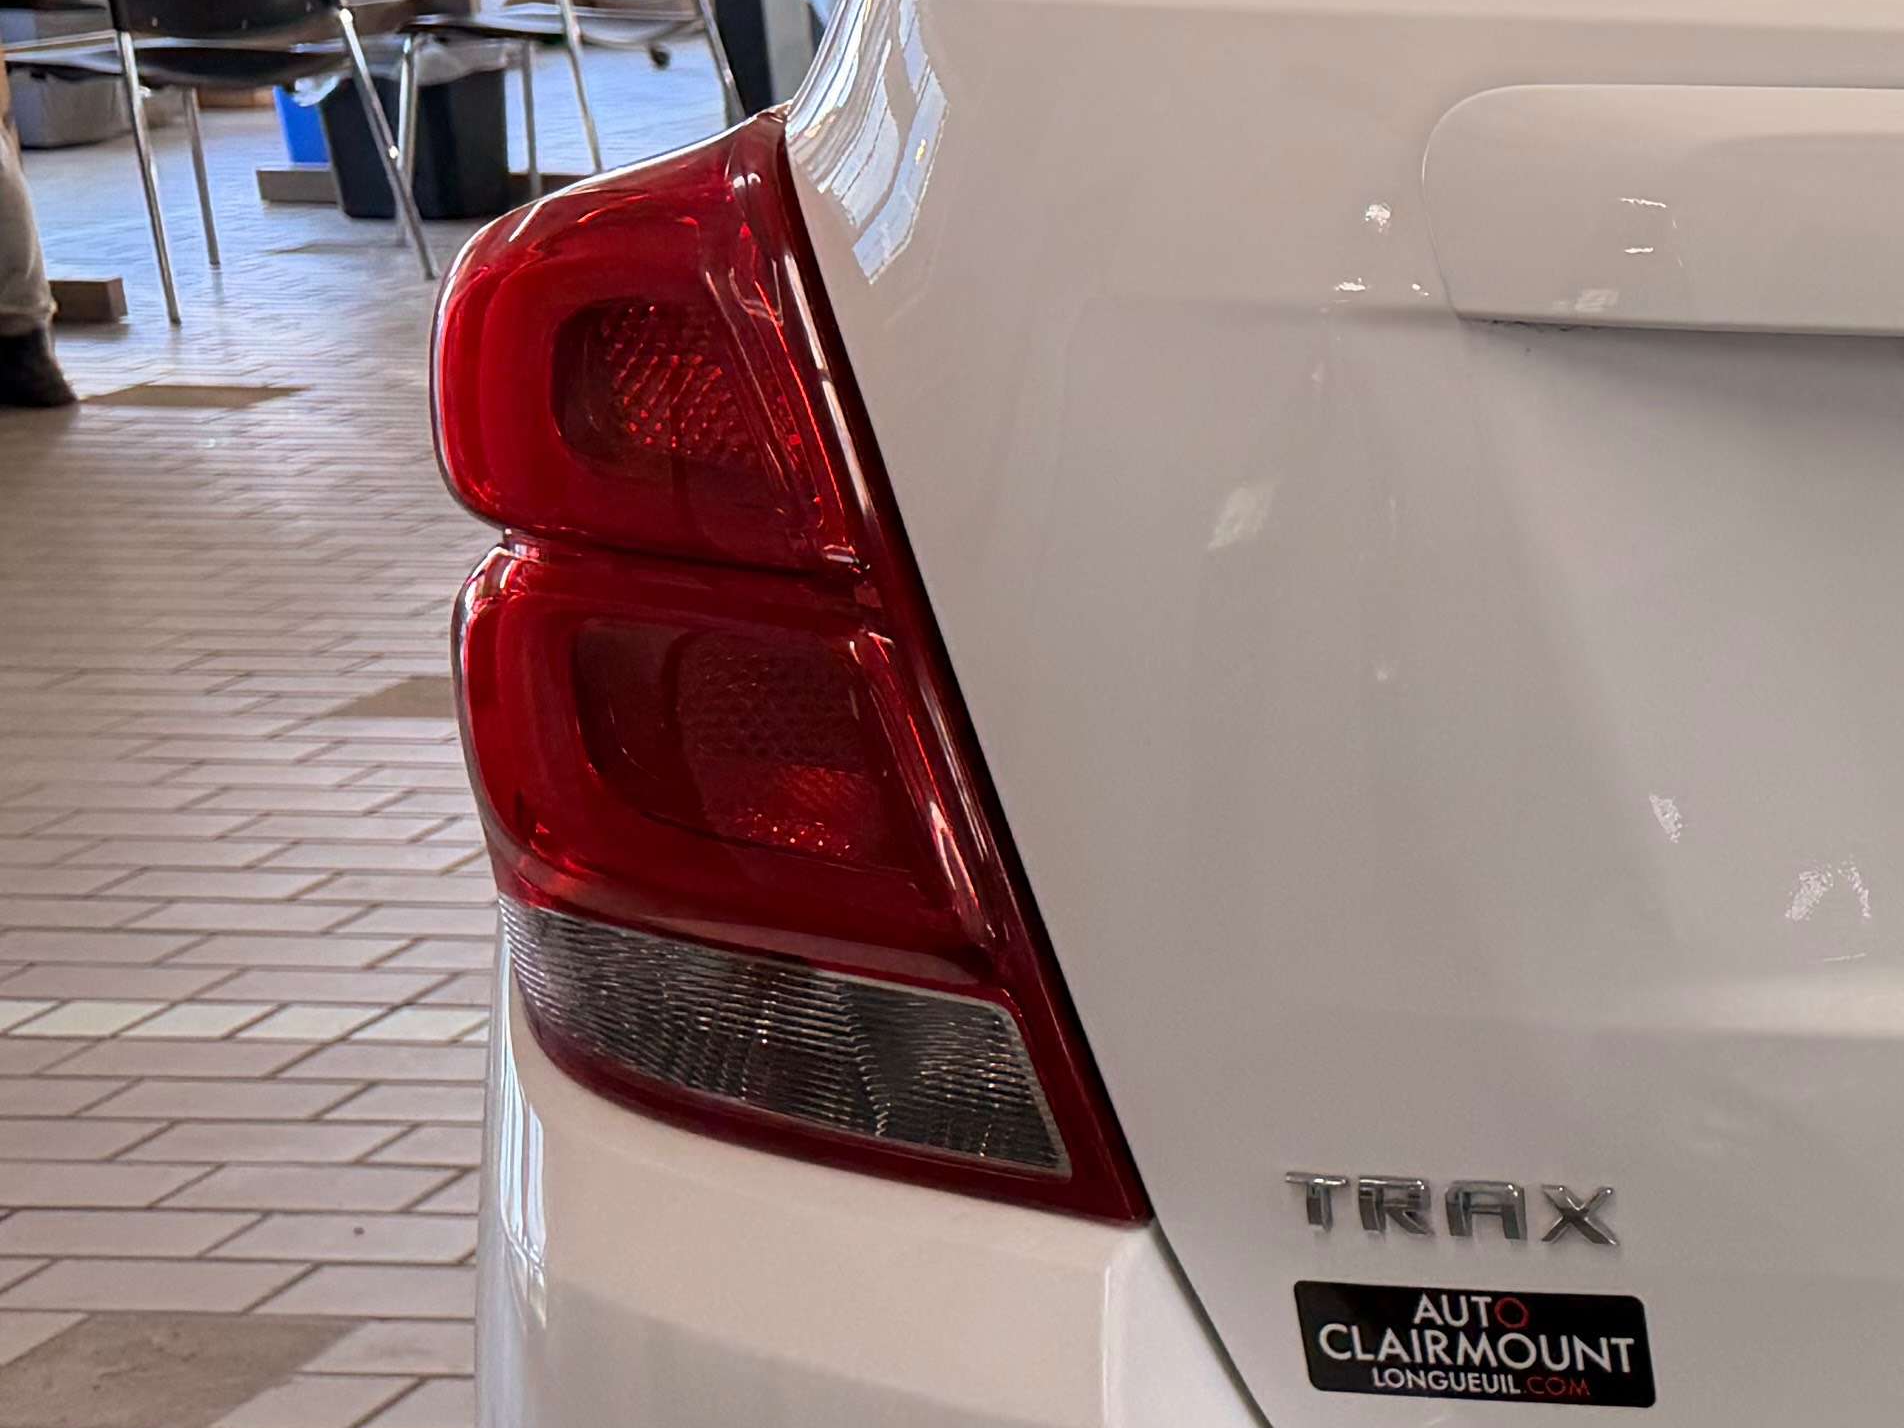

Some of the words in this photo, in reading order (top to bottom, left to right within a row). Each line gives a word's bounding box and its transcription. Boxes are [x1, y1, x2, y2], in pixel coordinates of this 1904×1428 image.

[1285, 1172, 1619, 1246] TRAX
[1413, 1292, 1529, 1329] AUTO
[1319, 1323, 1634, 1373] CLAIRMOUNT
[1373, 1368, 1590, 1396] LONGUEUIL.COM
